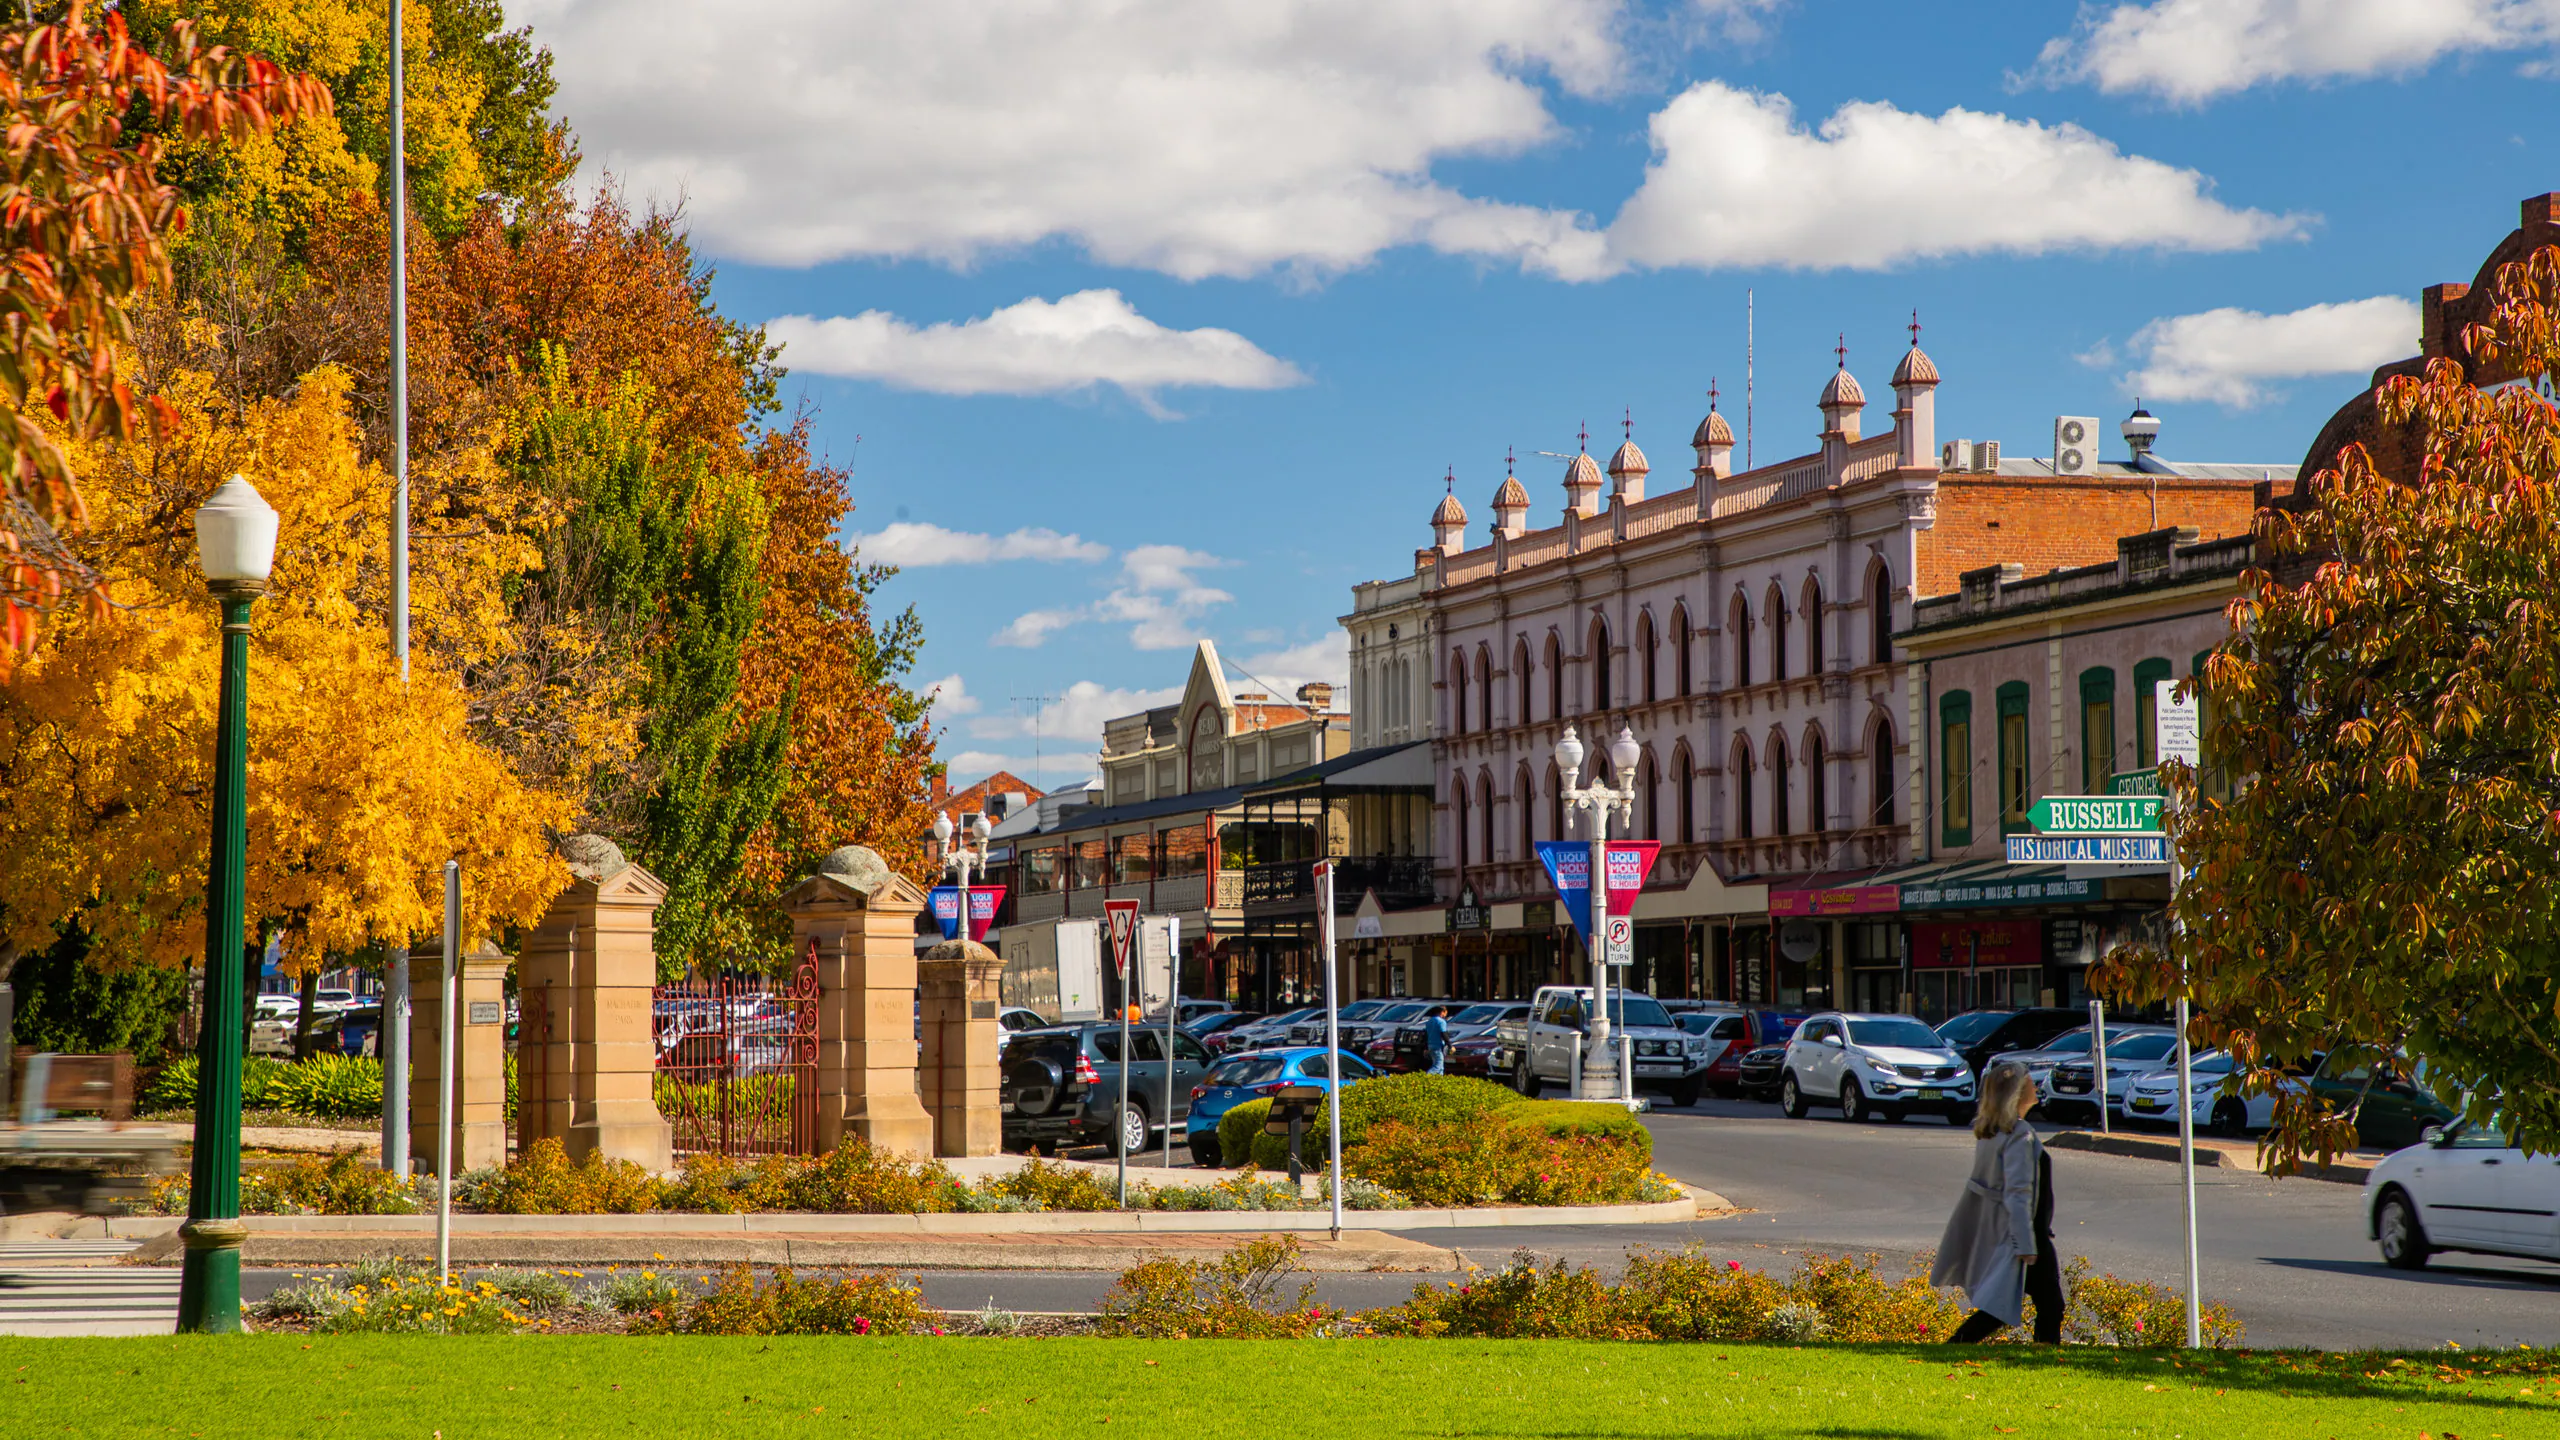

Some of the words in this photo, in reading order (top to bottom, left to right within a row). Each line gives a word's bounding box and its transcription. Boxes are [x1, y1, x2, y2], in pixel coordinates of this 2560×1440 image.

[1198, 717, 1216, 736] READ
[2118, 774, 2159, 796] GEORGE
[2050, 802, 2142, 829] RUSSELL
[2144, 802, 2157, 816] ST
[2010, 838, 2096, 860] HISTORICAL
[2100, 838, 2160, 859] MUSEUM
[1558, 853, 1587, 863] LIQUI
[1609, 853, 1638, 862] LIQUI
[1559, 863, 1588, 874] MOLY
[1610, 863, 1639, 873] MOLY
[2046, 882, 2064, 896] BOXING
[2064, 882, 2068, 895] &
[2069, 880, 2088, 895] FITNESS
[1609, 944, 1621, 952] NO
[1624, 944, 1630, 952] U
